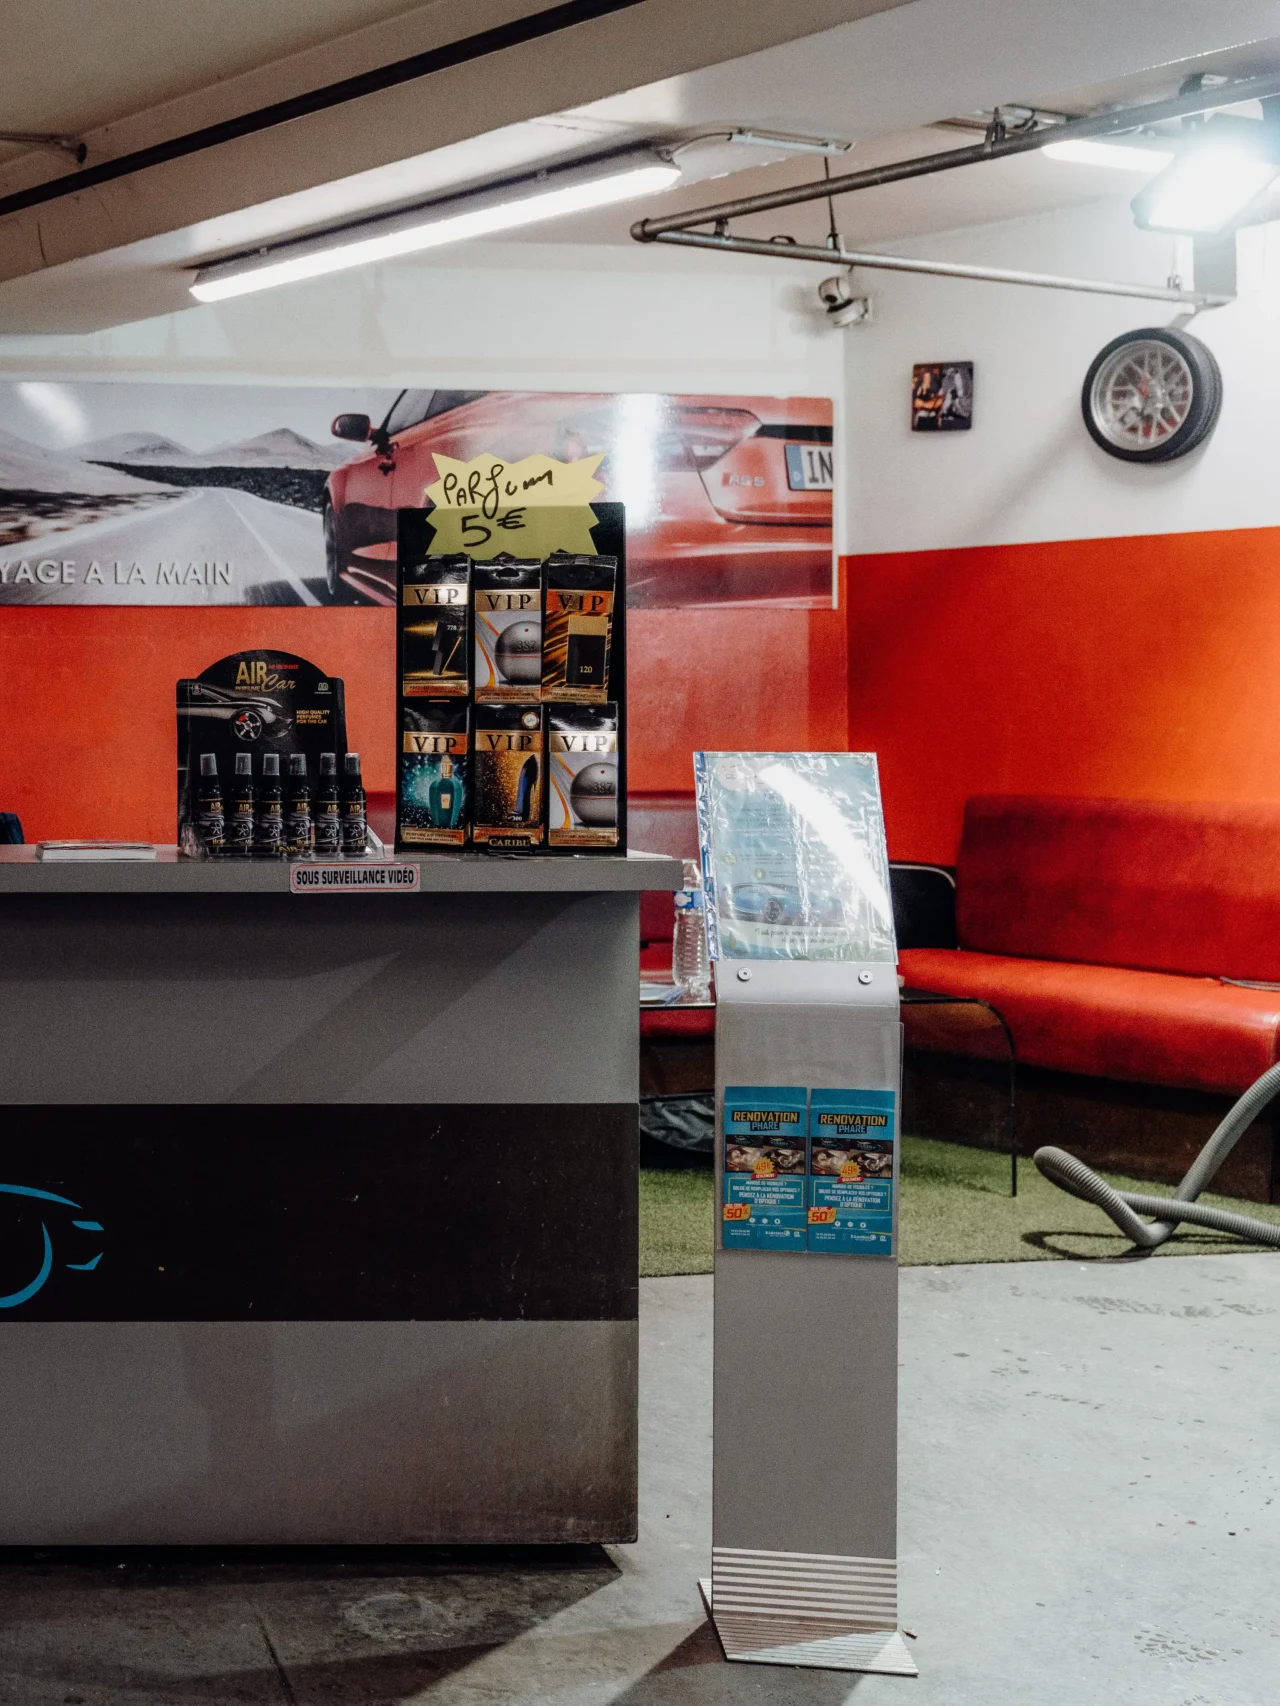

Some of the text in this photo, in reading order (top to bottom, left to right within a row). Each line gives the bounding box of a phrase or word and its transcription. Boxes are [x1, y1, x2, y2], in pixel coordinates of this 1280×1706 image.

[461, 507, 527, 547] 5€
[83, 561, 105, 585] A
[113, 561, 146, 585] LA
[156, 561, 233, 585] MAIN
[413, 589, 459, 605] VIP
[485, 594, 532, 610] VIP
[558, 595, 604, 611] VIP
[236, 661, 267, 684] AIR
[579, 665, 593, 674] 120
[261, 674, 296, 692] Car
[413, 736, 457, 752] VIP
[486, 734, 532, 751] VIP
[561, 736, 607, 752] VIP
[296, 867, 414, 884] SOUS SURVEILLANCE VIDÉO
[733, 1111, 798, 1122] RENOVATION
[820, 1115, 886, 1126] RENOVATION
[752, 1122, 779, 1130] PHARE
[839, 1125, 866, 1133] PHARE
